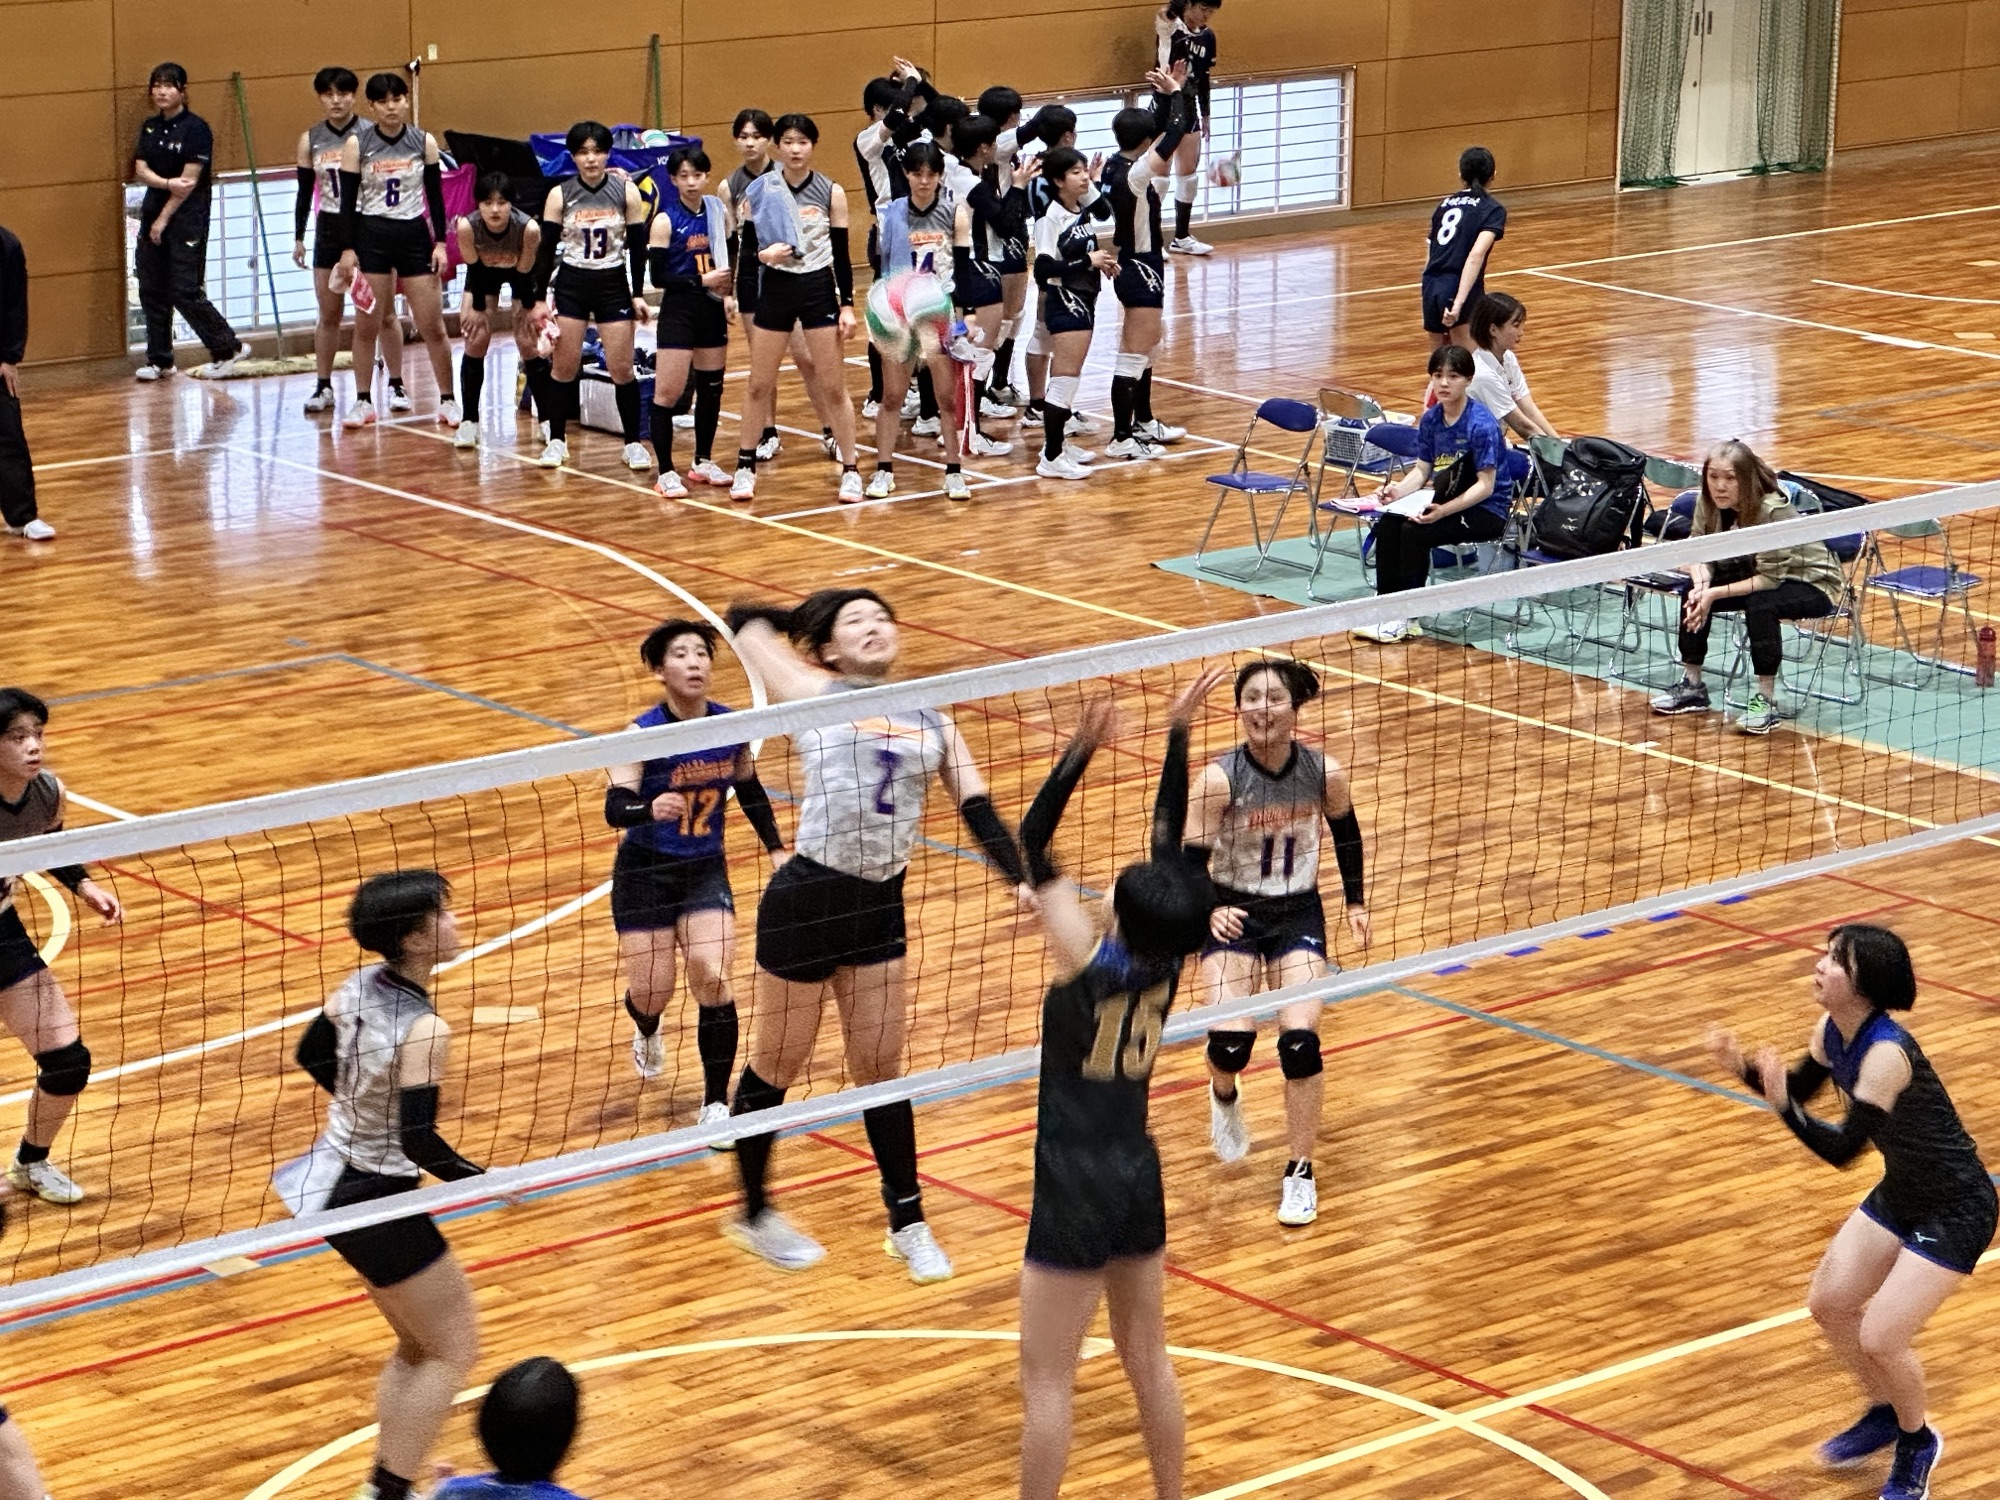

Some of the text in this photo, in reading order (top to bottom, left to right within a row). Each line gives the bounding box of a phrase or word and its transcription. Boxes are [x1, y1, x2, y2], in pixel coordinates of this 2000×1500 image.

[386, 178, 400, 207] 6
[582, 227, 607, 259] 13
[1437, 207, 1462, 245] 8
[911, 251, 936, 274] 14
[873, 749, 902, 815] 2
[678, 788, 720, 837] 12
[1261, 835, 1296, 877] 11
